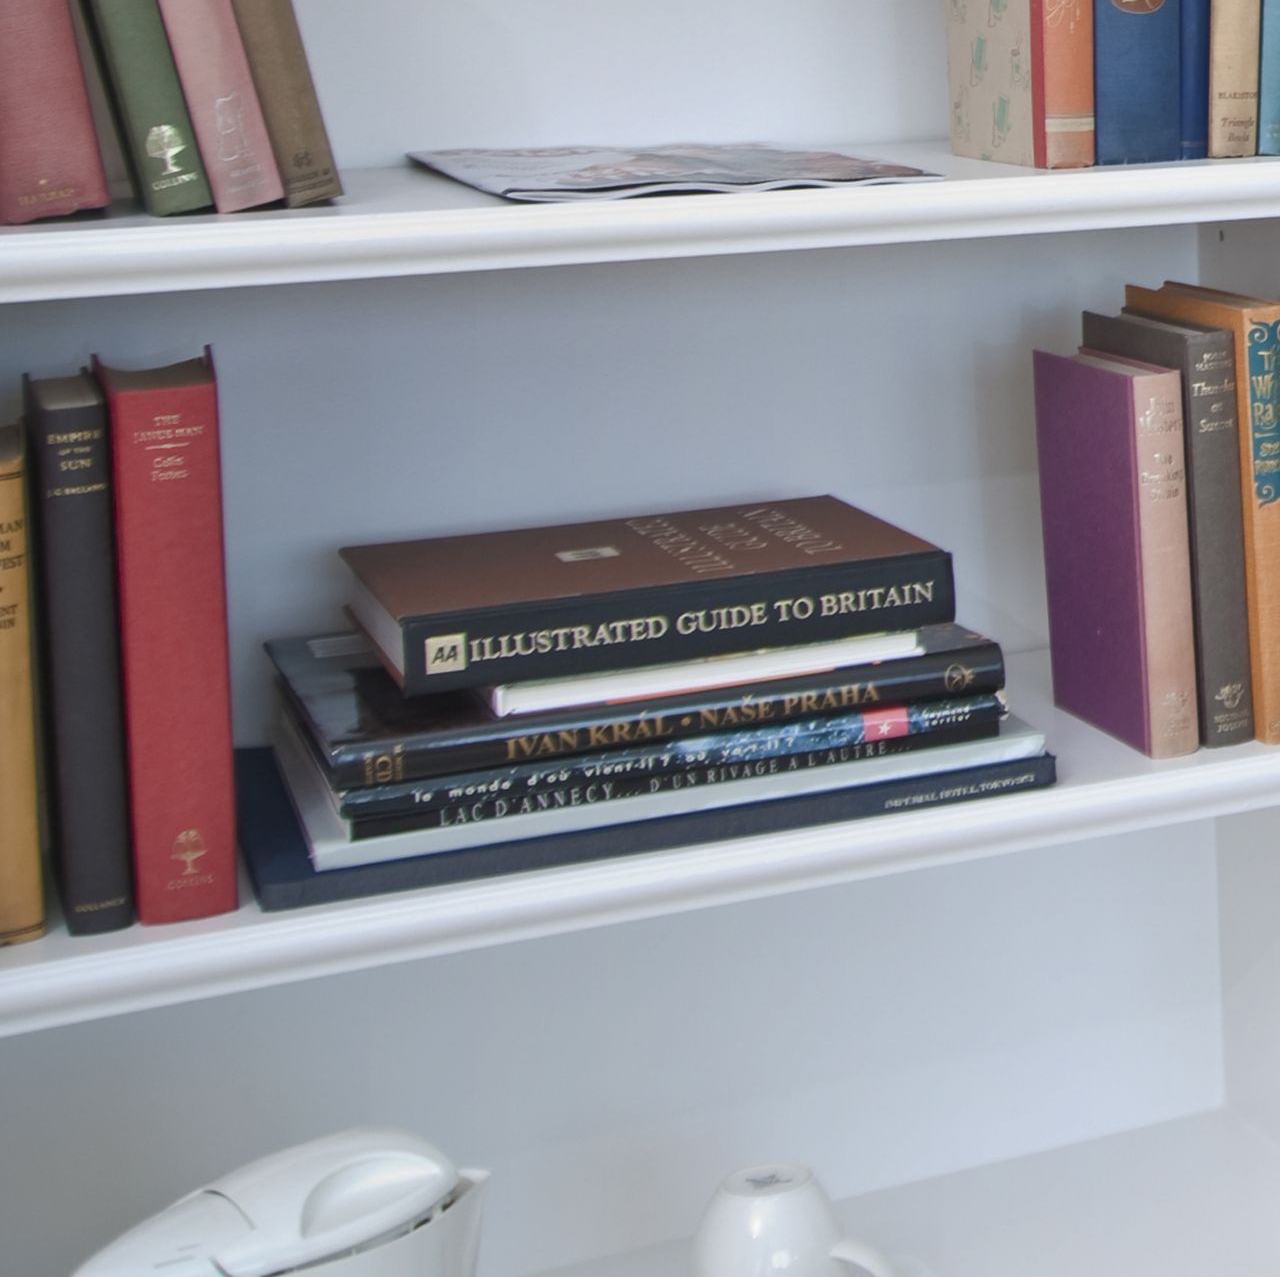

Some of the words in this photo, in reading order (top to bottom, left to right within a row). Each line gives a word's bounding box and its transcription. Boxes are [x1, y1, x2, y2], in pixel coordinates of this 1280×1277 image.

[60, 458, 92, 472] SUN
[431, 642, 459, 664] AA
[469, 615, 669, 663] ILLUSTRATED
[676, 604, 768, 636] GUIDE
[773, 597, 815, 622] TO
[820, 580, 935, 618] BRITAIN
[506, 729, 578, 760] IVAN
[589, 709, 674, 746] KRÁL
[699, 693, 776, 726] NAŠE
[784, 681, 881, 715] PRAHA
[440, 803, 483, 826] LAC
[650, 774, 698, 794] D'UN
[707, 760, 778, 783] RIVAGE
[449, 778, 512, 799] monde
